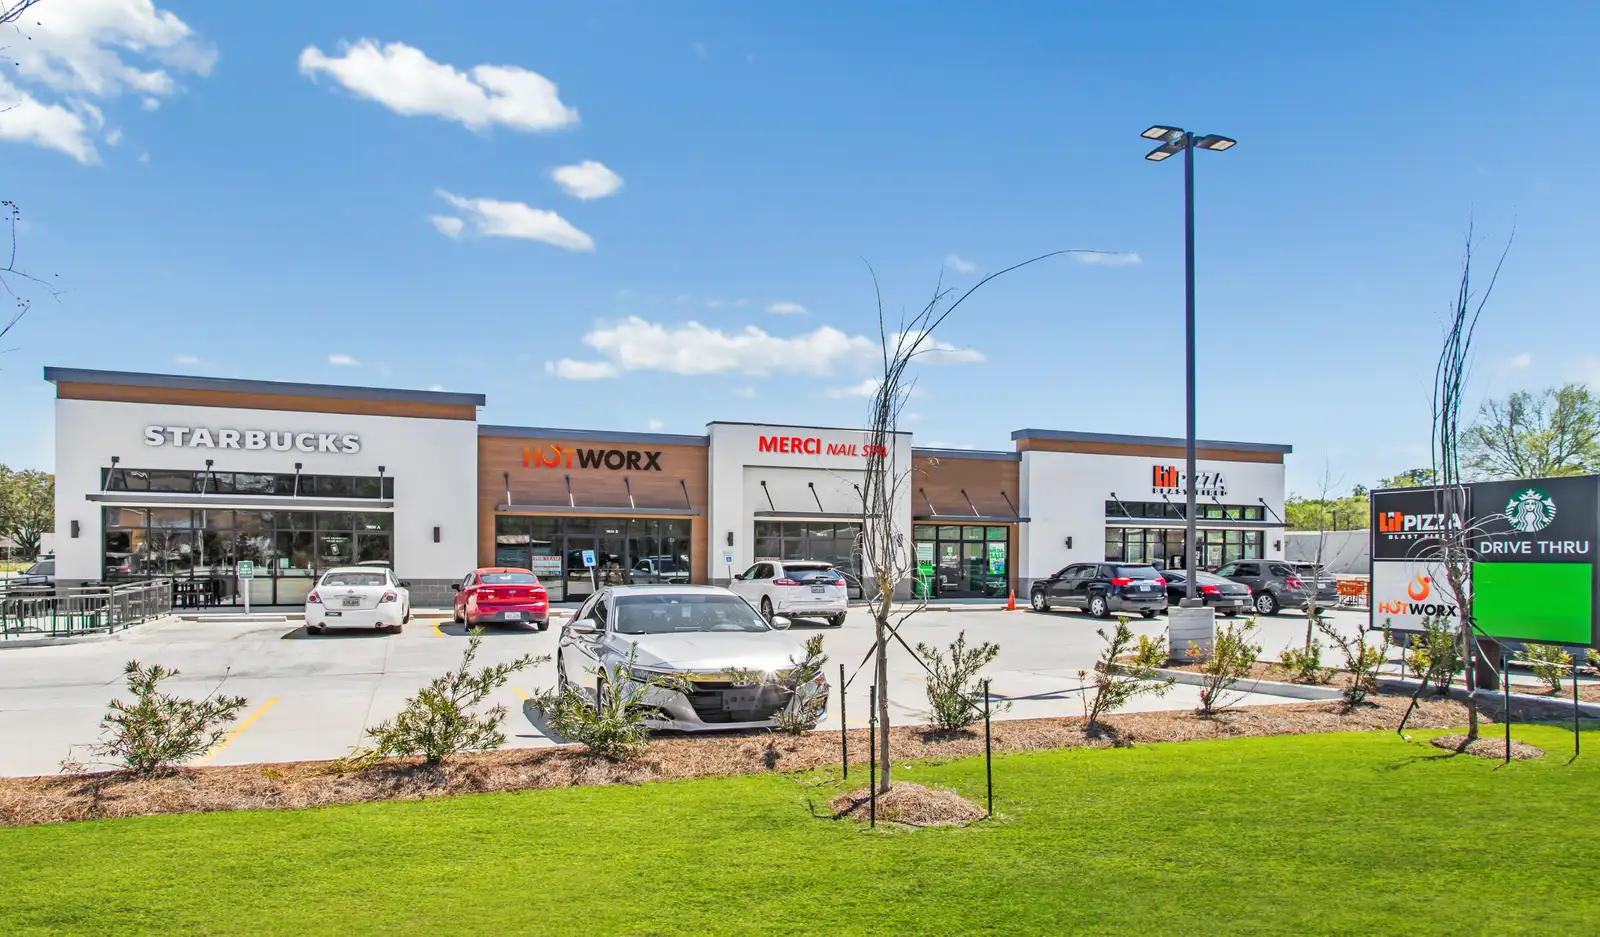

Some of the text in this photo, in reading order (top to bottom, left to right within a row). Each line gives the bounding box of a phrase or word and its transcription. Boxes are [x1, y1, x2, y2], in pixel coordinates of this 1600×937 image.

[144, 425, 361, 454] STARBUCKS
[758, 435, 887, 457] MERCI NAIL SPA
[523, 444, 662, 472] HOTWORX
[1480, 540, 1590, 554] DRIVE THRU
[1379, 600, 1457, 617] HOTWORX
